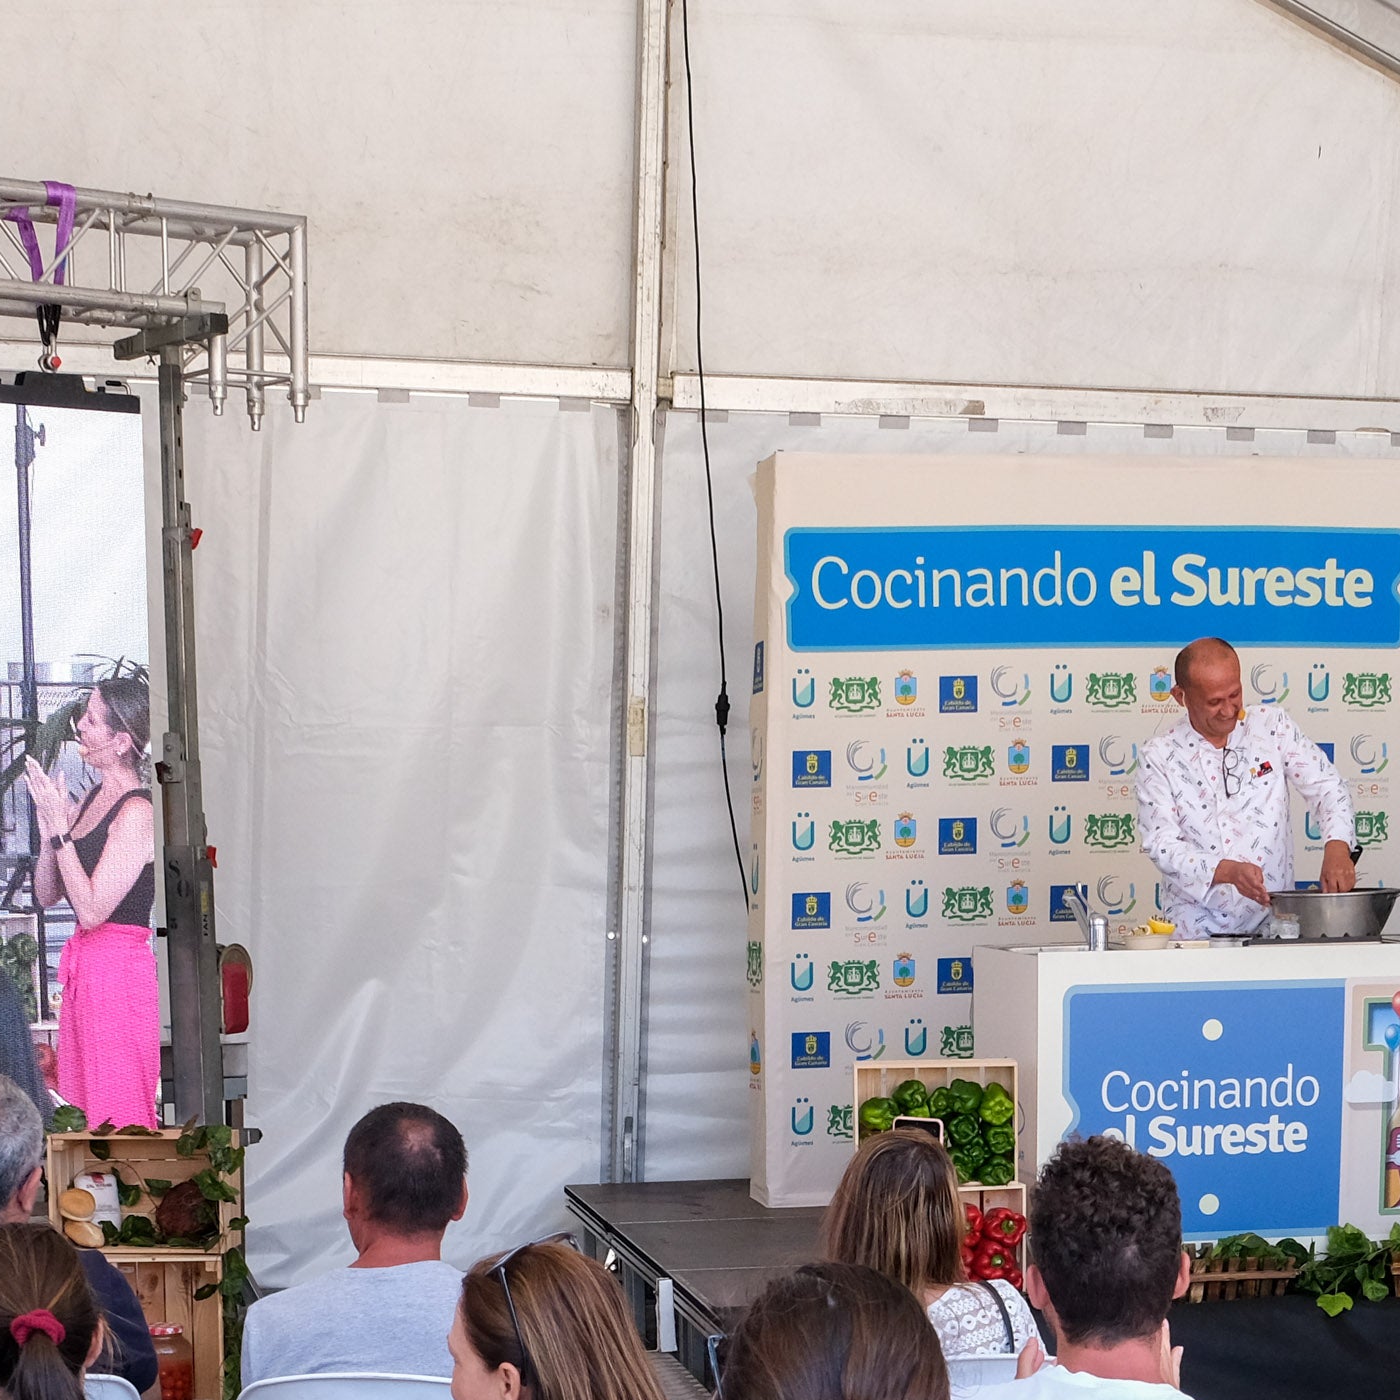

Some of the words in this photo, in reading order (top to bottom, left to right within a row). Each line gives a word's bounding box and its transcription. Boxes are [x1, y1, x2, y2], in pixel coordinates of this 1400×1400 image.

[811, 550, 1097, 610] Cocinando
[1110, 550, 1160, 606] el
[1170, 553, 1374, 608] Sureste
[1100, 1063, 1321, 1114] Cocinando
[1147, 1116, 1308, 1159] Sureste
